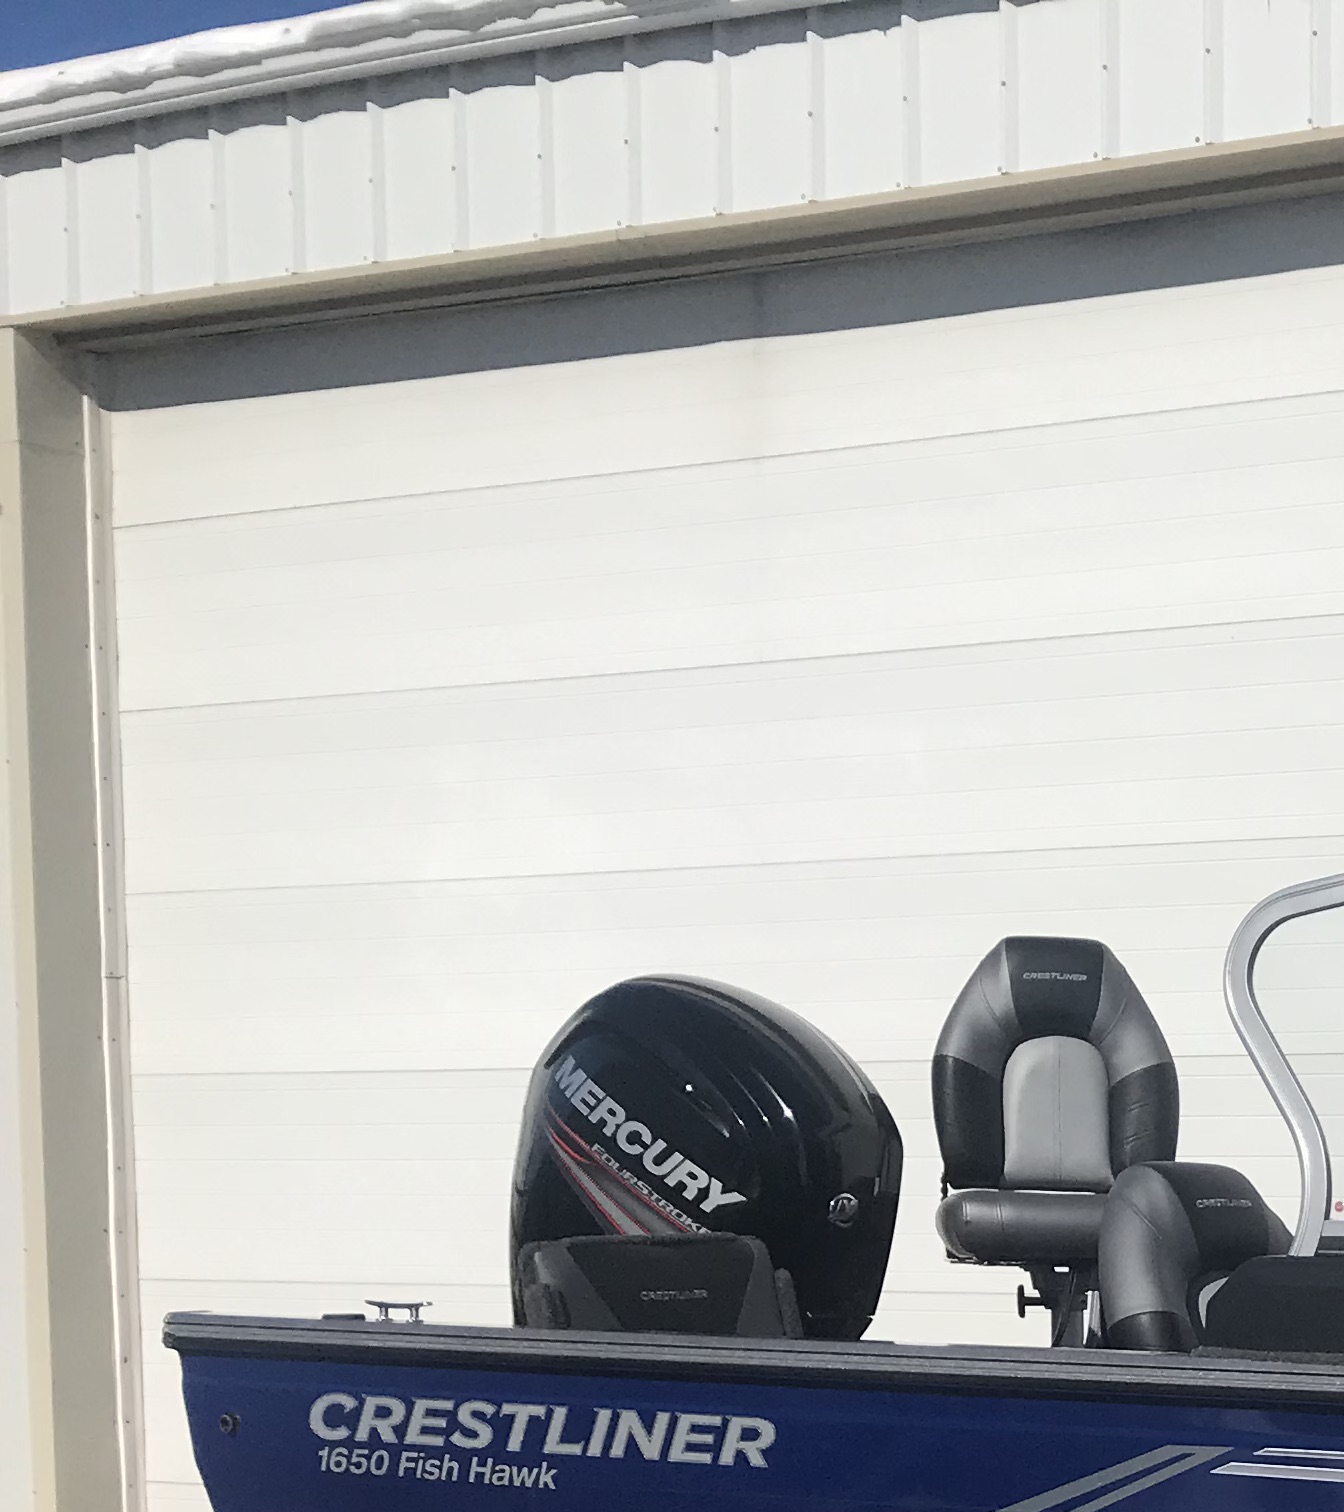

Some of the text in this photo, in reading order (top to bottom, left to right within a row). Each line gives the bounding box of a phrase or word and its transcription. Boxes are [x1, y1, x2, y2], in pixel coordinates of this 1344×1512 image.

[1022, 971, 1088, 981] CRESTLINER
[554, 1054, 748, 1213] MERCURY
[308, 1391, 777, 1468] CRESTLINER
[317, 1445, 558, 1490] 1650 Fish Hawk
